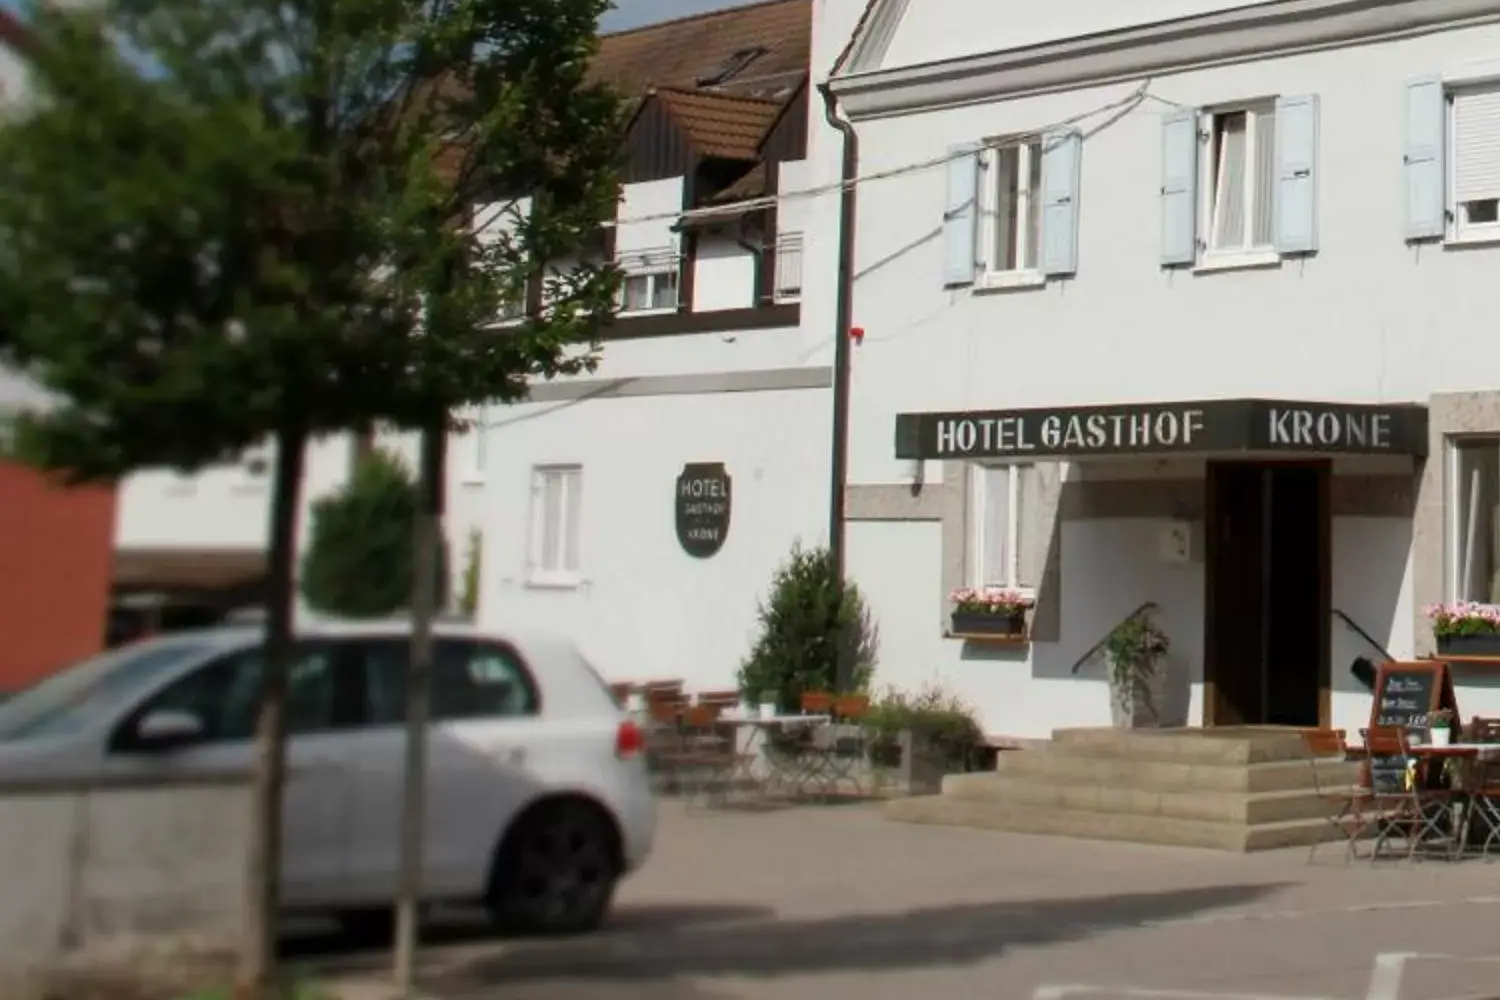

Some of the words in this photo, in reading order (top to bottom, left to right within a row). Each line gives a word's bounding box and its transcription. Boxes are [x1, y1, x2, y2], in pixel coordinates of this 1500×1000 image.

[937, 417, 1035, 453] HOTEL
[1040, 410, 1204, 448] GASTHOF
[1269, 408, 1391, 448] KRONE
[681, 479, 727, 498] HOTEL
